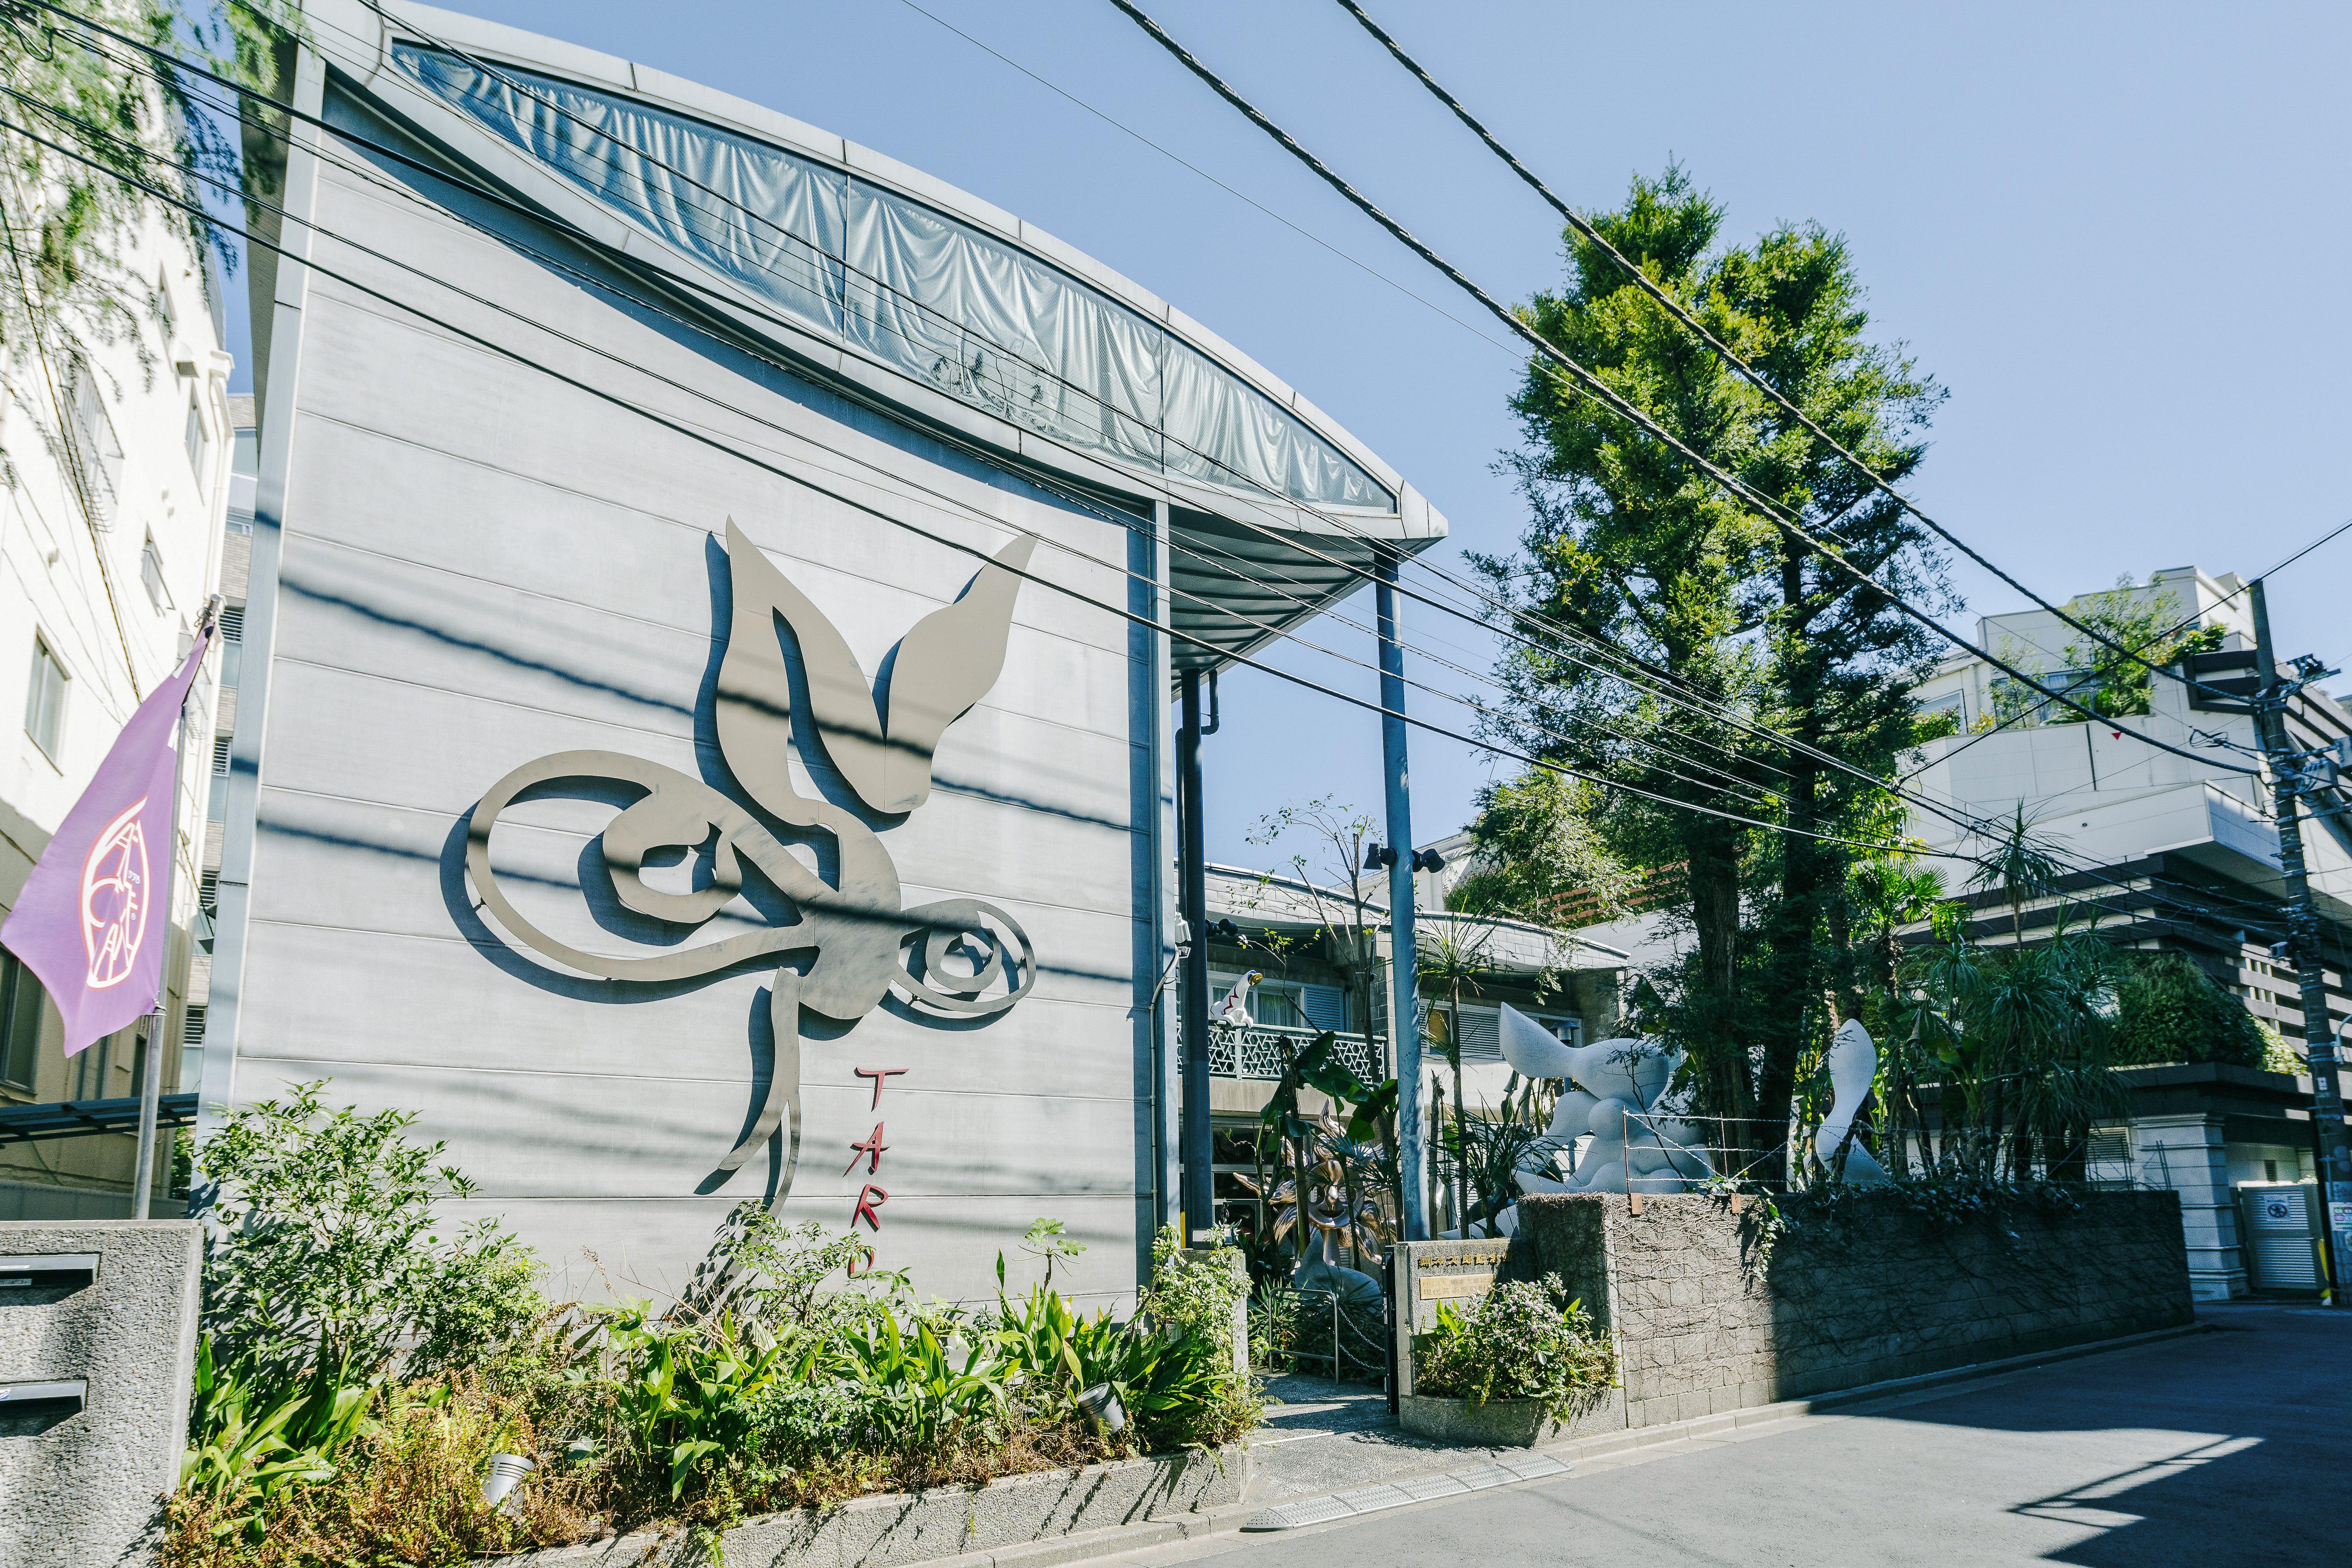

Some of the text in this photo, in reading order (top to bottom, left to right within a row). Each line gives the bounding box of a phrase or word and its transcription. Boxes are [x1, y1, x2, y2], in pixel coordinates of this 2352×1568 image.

[843, 1067, 909, 1278] TARO
[1424, 1285, 1491, 1296] 現代芸術振興財
